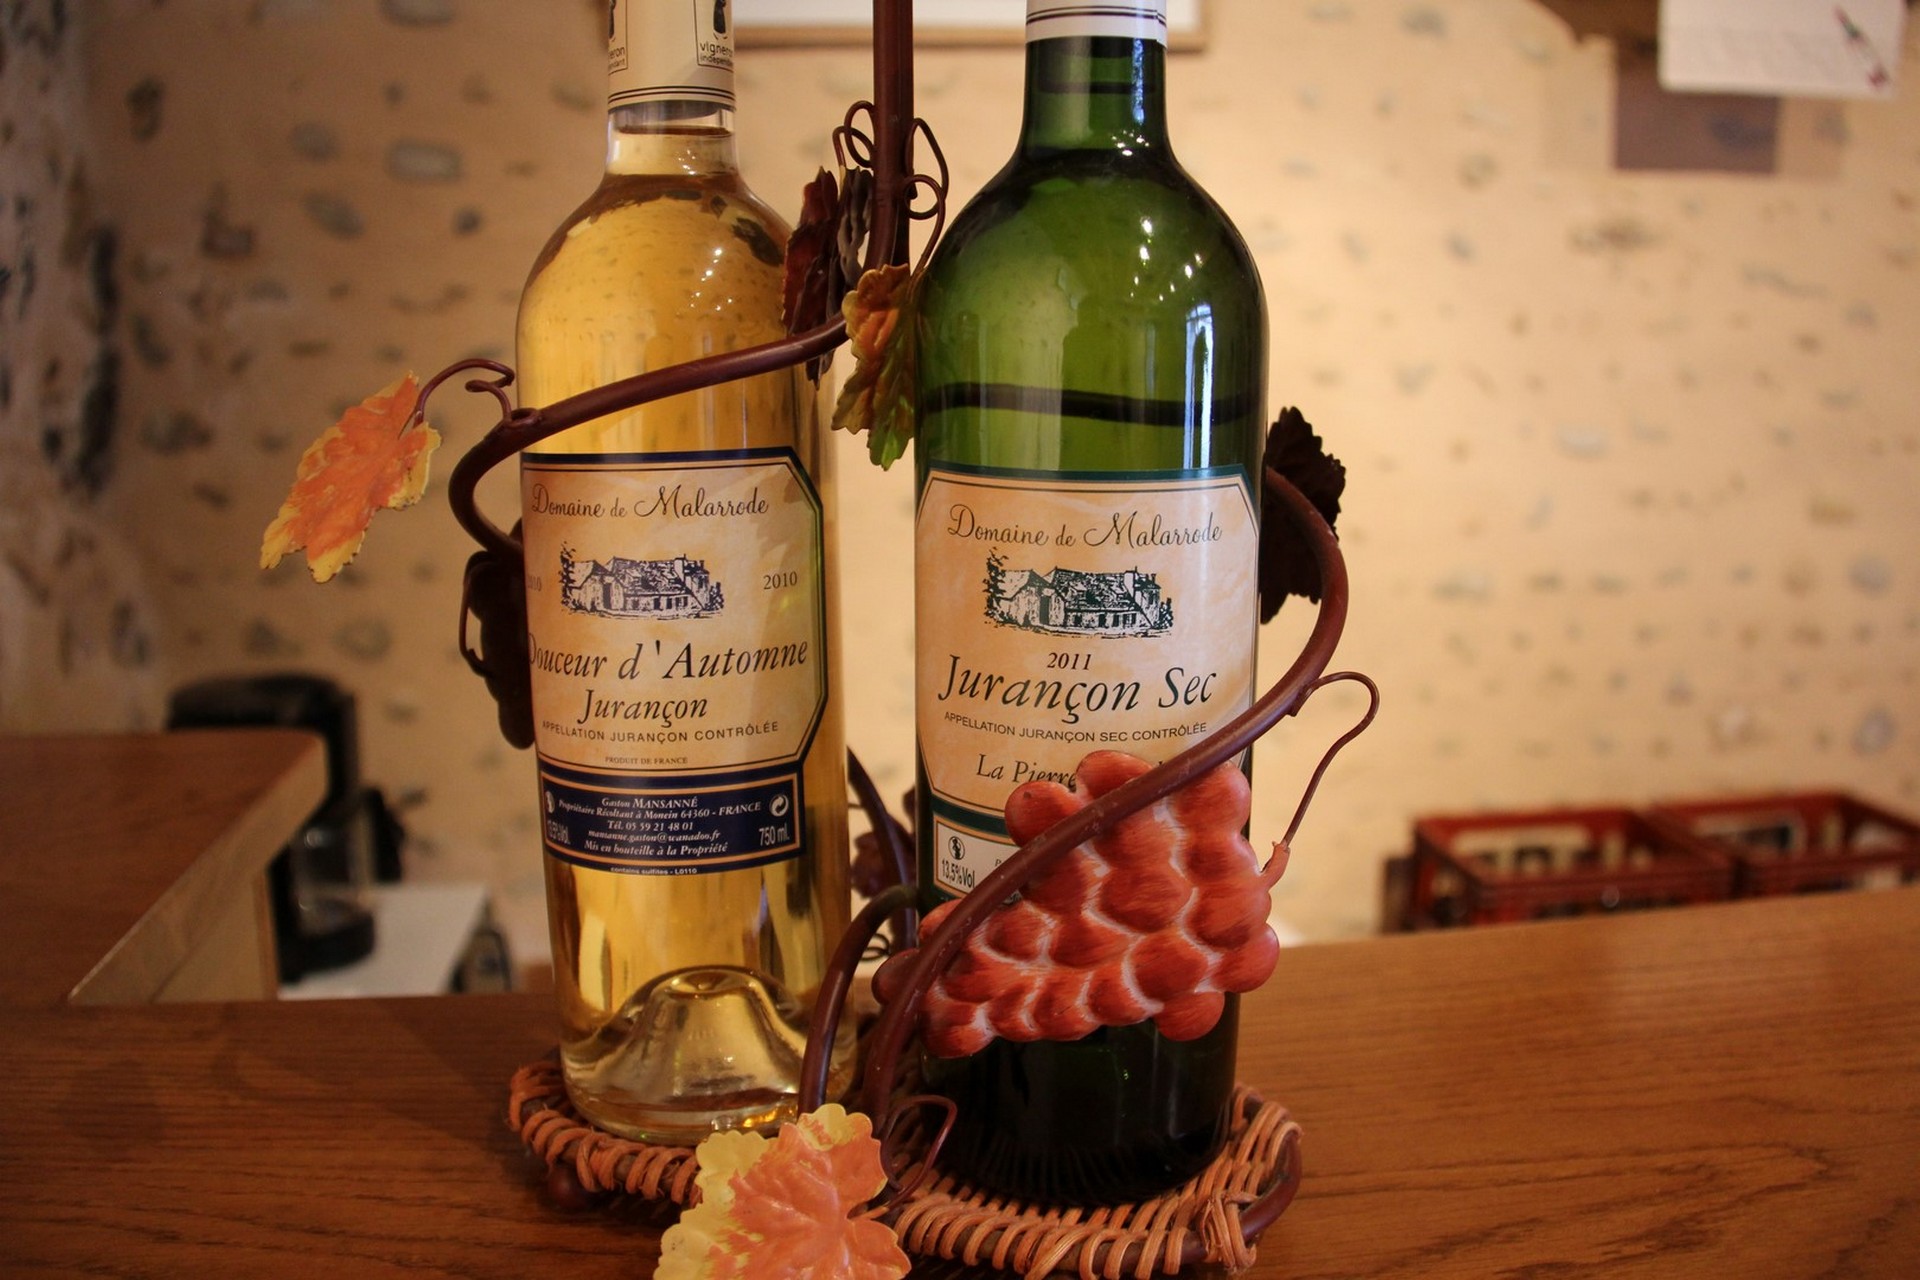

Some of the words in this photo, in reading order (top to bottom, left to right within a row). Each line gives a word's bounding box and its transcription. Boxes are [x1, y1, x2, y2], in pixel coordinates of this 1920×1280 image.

[531, 483, 605, 518] Domaine
[610, 497, 628, 518] de
[634, 484, 769, 519] Malarrode
[947, 504, 1049, 546] Domaine
[1056, 524, 1076, 547] de
[1083, 511, 1223, 548] Malarrode
[763, 570, 798, 590] 2010
[1047, 652, 1092, 671] 2011
[938, 654, 1140, 724] Jurançon
[1158, 666, 1217, 709] Sec
[577, 689, 708, 729] Jurançon
[542, 720, 605, 740] APPELLATION
[610, 732, 688, 745] JURANÇON
[694, 720, 779, 741] CONTRÔLÉE
[944, 711, 1016, 736] APPELLATION
[1019, 728, 1095, 744] JURANÇON
[1099, 730, 1128, 742] SEC
[1132, 722, 1208, 742] CONTRÔLÉE
[605, 756, 638, 765] PRODUIT
[641, 757, 652, 765] DE
[654, 756, 688, 765] FRANCE
[976, 753, 1004, 780] La
[558, 799, 595, 815] Propriétaire
[596, 807, 634, 819] Récoltant
[680, 809, 710, 819] 64360
[718, 801, 761, 816] FRANCE
[601, 797, 630, 809] Gaston
[632, 796, 698, 809] MANSANNÉ
[608, 820, 624, 830] Tél.
[625, 822, 637, 831] 05
[639, 822, 651, 831] 59
[653, 822, 664, 831] 21
[668, 822, 680, 831] 48
[682, 822, 693, 831] 01
[759, 826, 775, 846] 750
[584, 840, 599, 851] Mis
[600, 843, 612, 852] en
[614, 844, 655, 856] bouteille
[657, 846, 664, 855] à
[666, 846, 677, 855] la
[680, 841, 728, 857] Propriété
